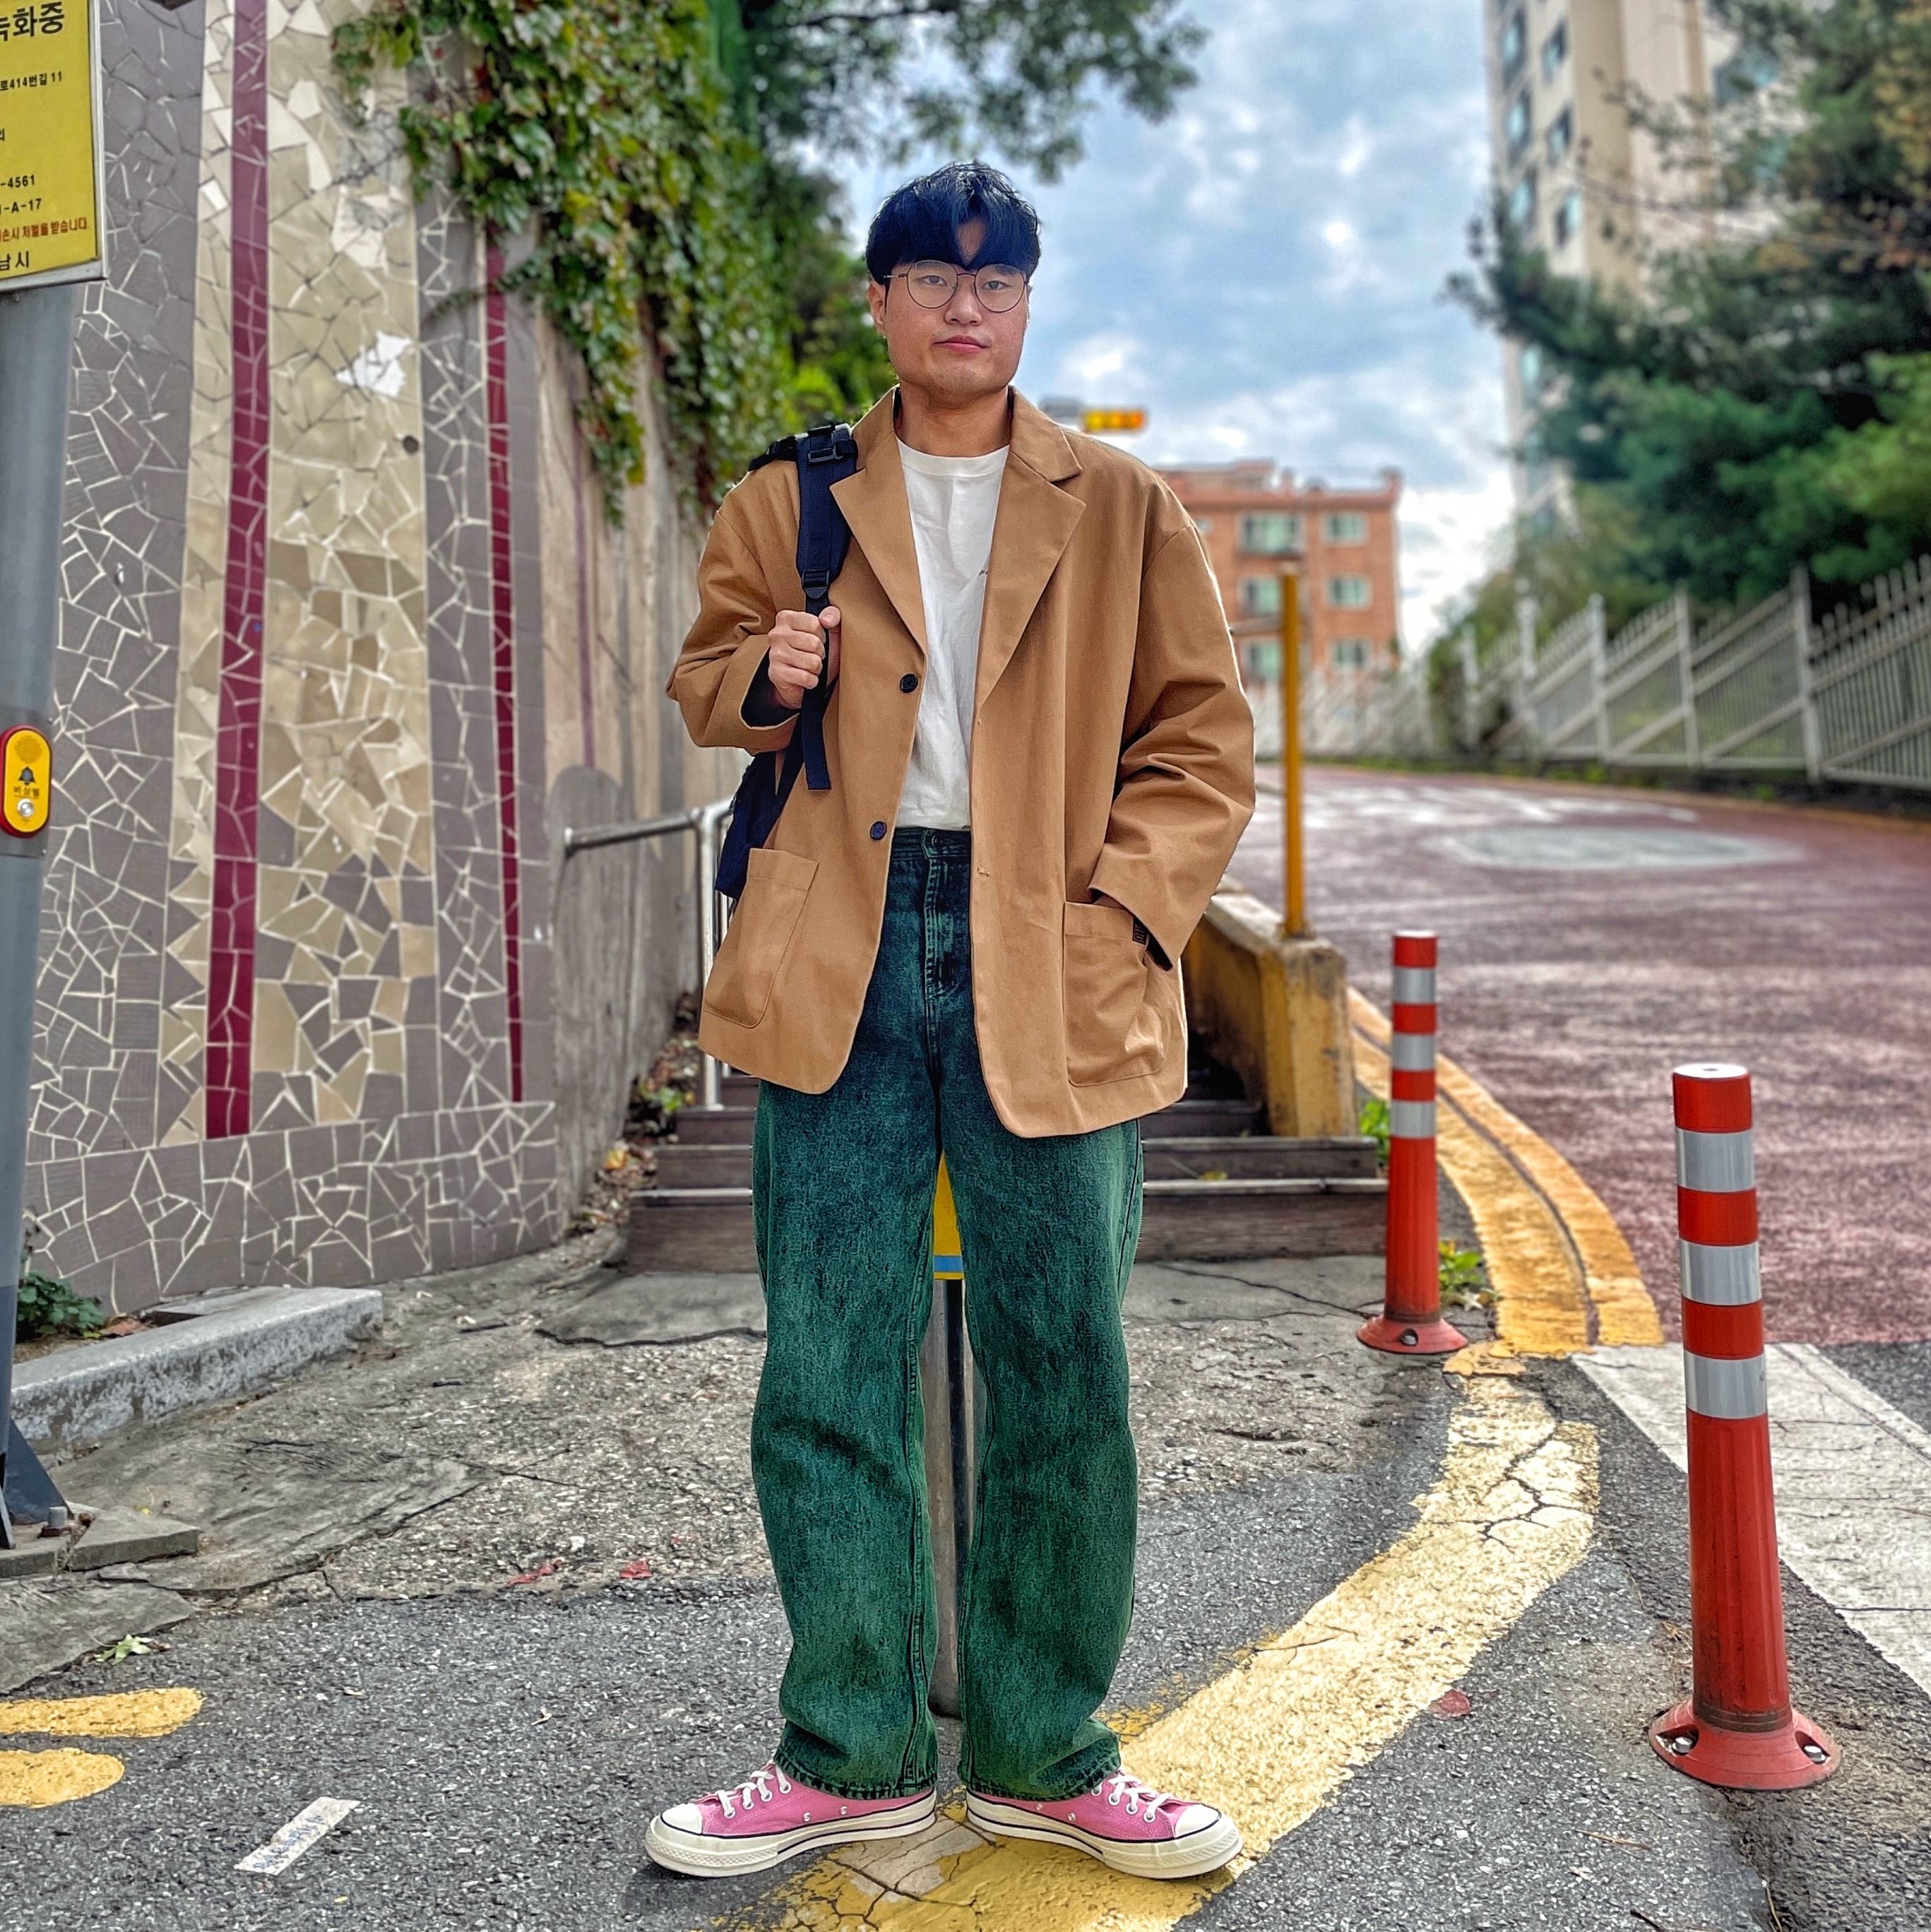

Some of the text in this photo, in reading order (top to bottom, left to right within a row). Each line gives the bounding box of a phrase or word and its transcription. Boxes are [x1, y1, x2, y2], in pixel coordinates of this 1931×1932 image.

[52, 71, 61, 82] 11
[1, 174, 35, 189] -4561
[0, 227, 20, 242] 손시
